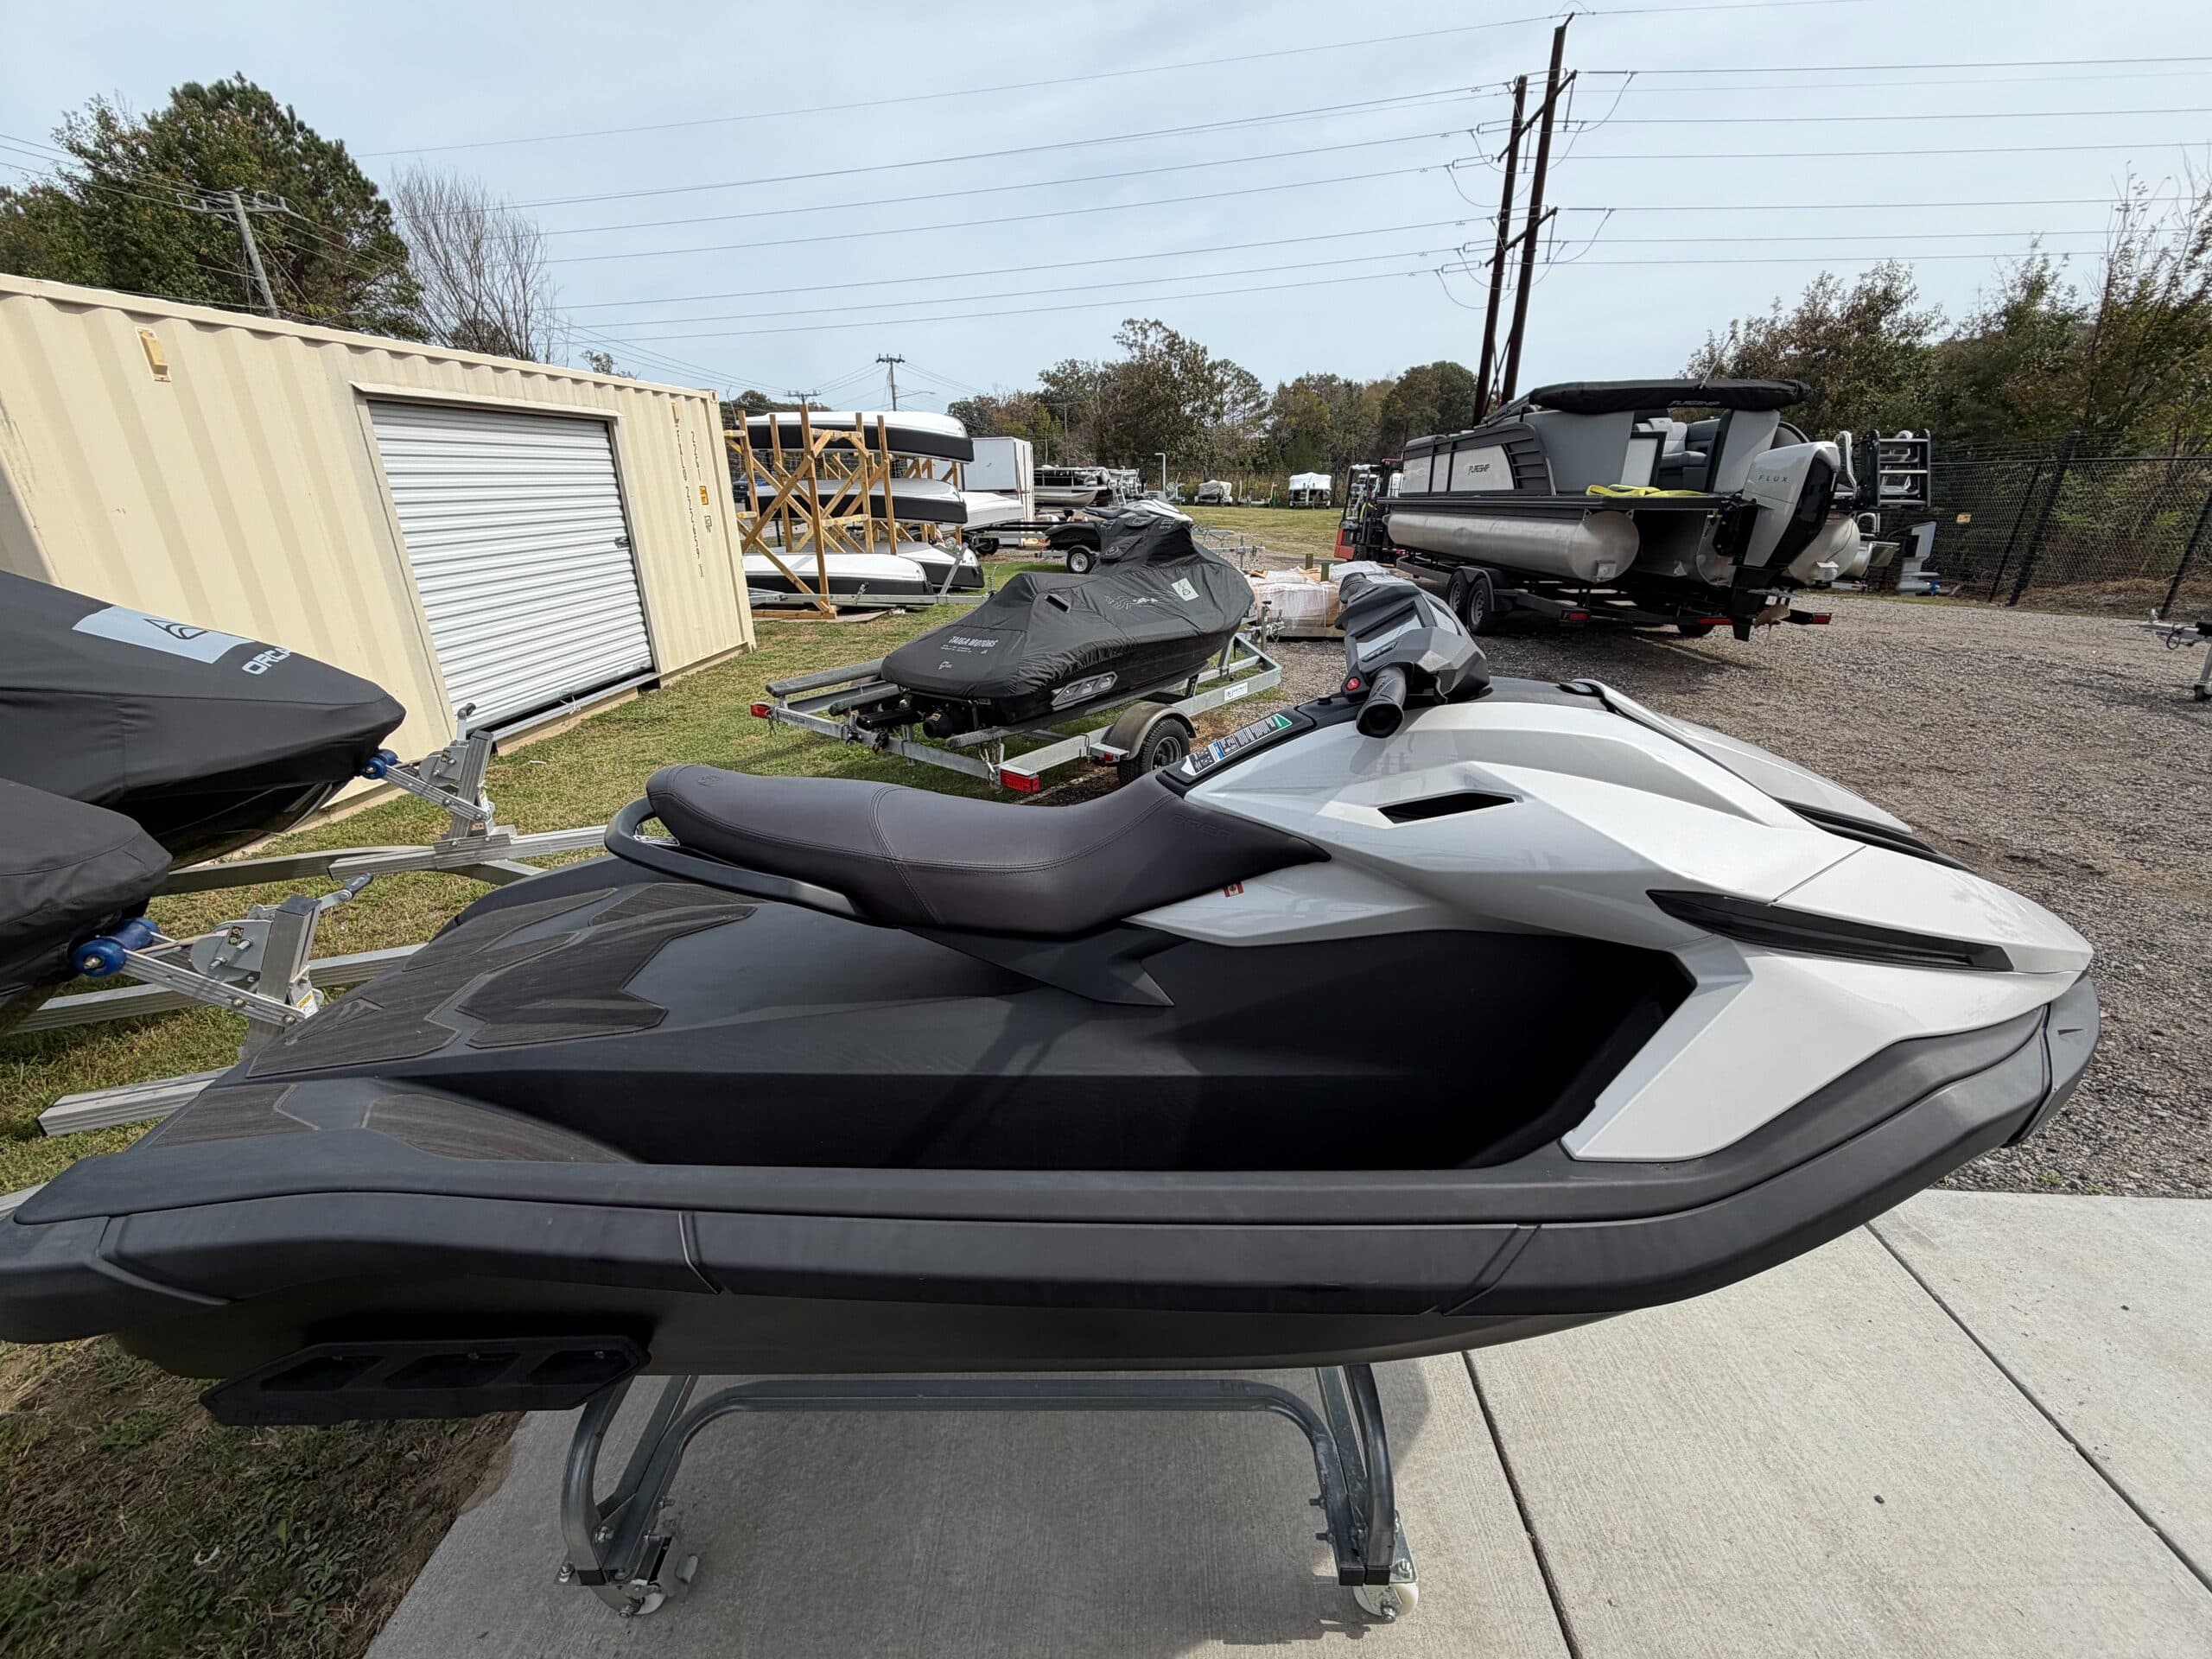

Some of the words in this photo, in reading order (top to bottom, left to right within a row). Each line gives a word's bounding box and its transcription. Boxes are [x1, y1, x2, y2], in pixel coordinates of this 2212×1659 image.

[1468, 463, 1491, 476] FLAGSHIP
[948, 635, 971, 645] TAIGA
[968, 639, 999, 648] MOTORS
[242, 647, 291, 675] ORCA
